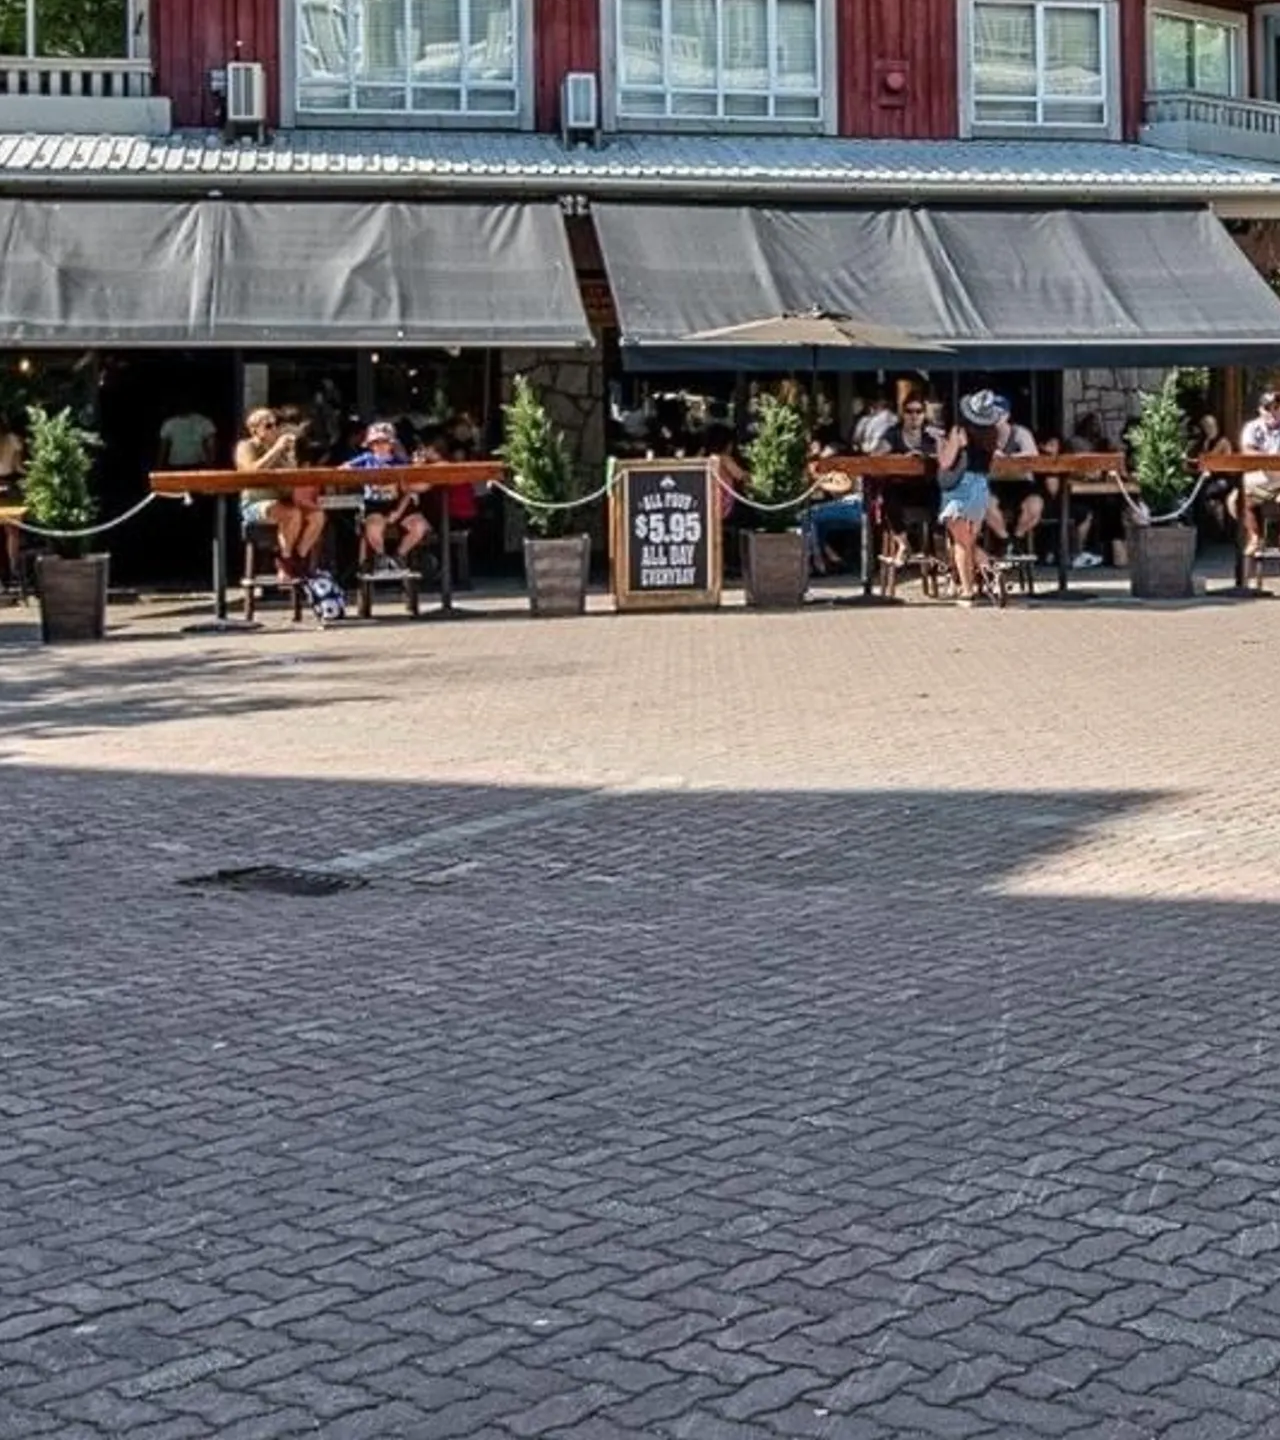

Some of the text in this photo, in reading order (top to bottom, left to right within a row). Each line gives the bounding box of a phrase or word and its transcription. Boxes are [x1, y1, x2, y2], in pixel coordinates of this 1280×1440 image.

[634, 512, 702, 543] $5.95
[641, 544, 695, 567] ALL DAY
